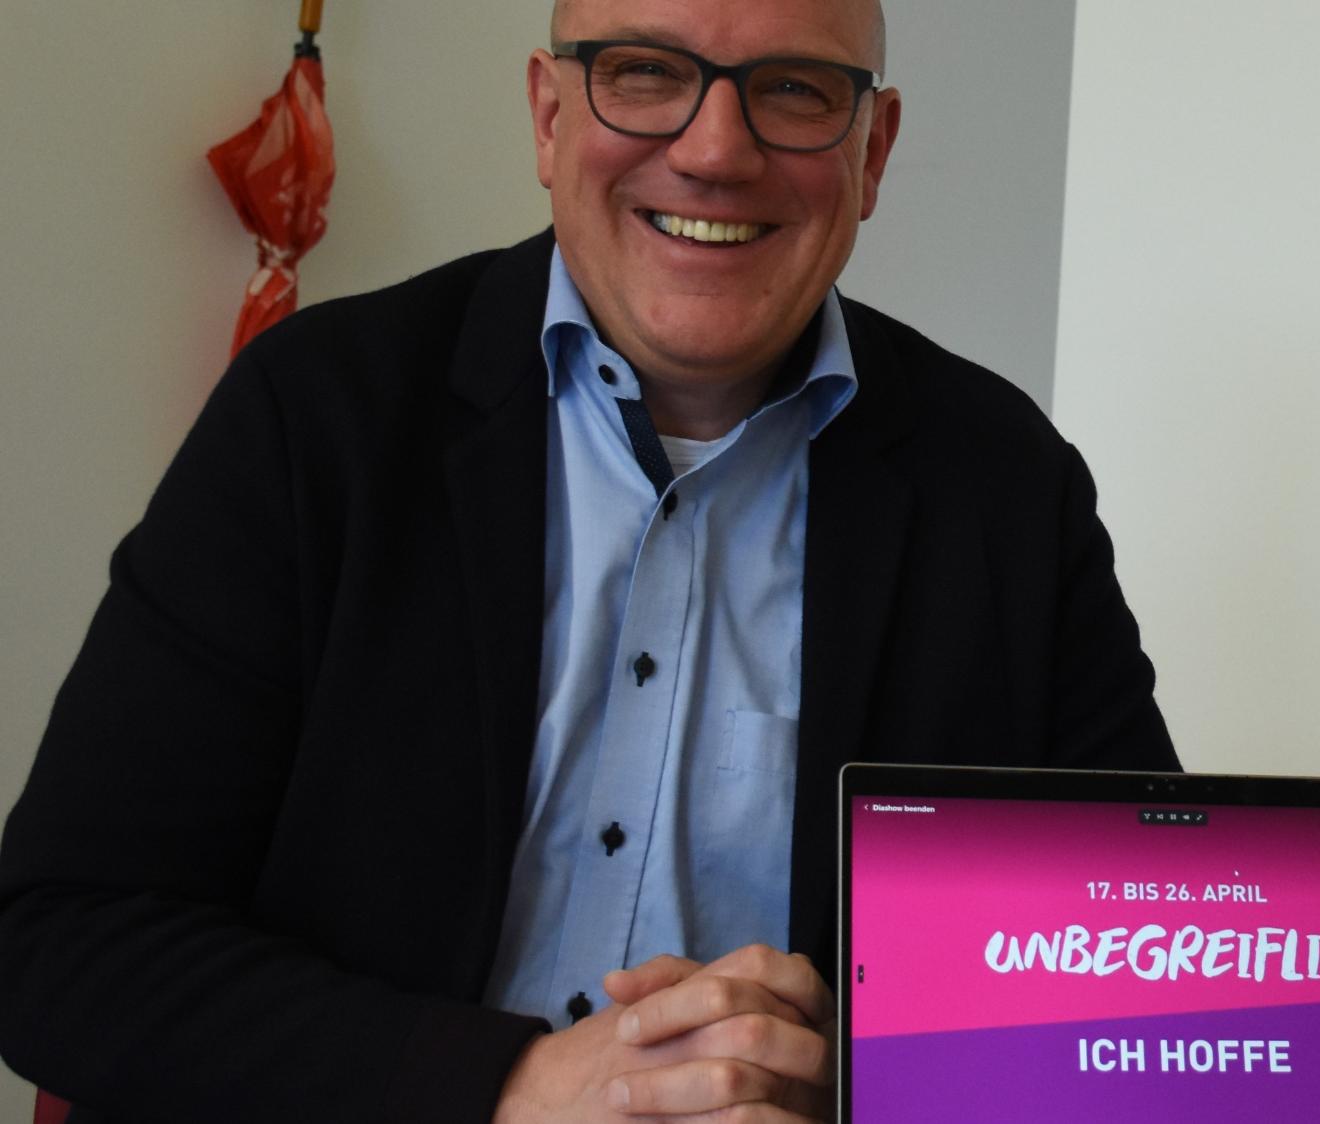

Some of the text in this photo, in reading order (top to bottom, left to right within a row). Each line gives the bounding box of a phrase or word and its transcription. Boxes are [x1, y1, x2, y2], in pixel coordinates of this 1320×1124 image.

[872, 804, 936, 813] Diashow beenden
[1087, 881, 1268, 903] 17. BIS 26. APRIL
[1078, 1038, 1292, 1073] ICH HOFFE
